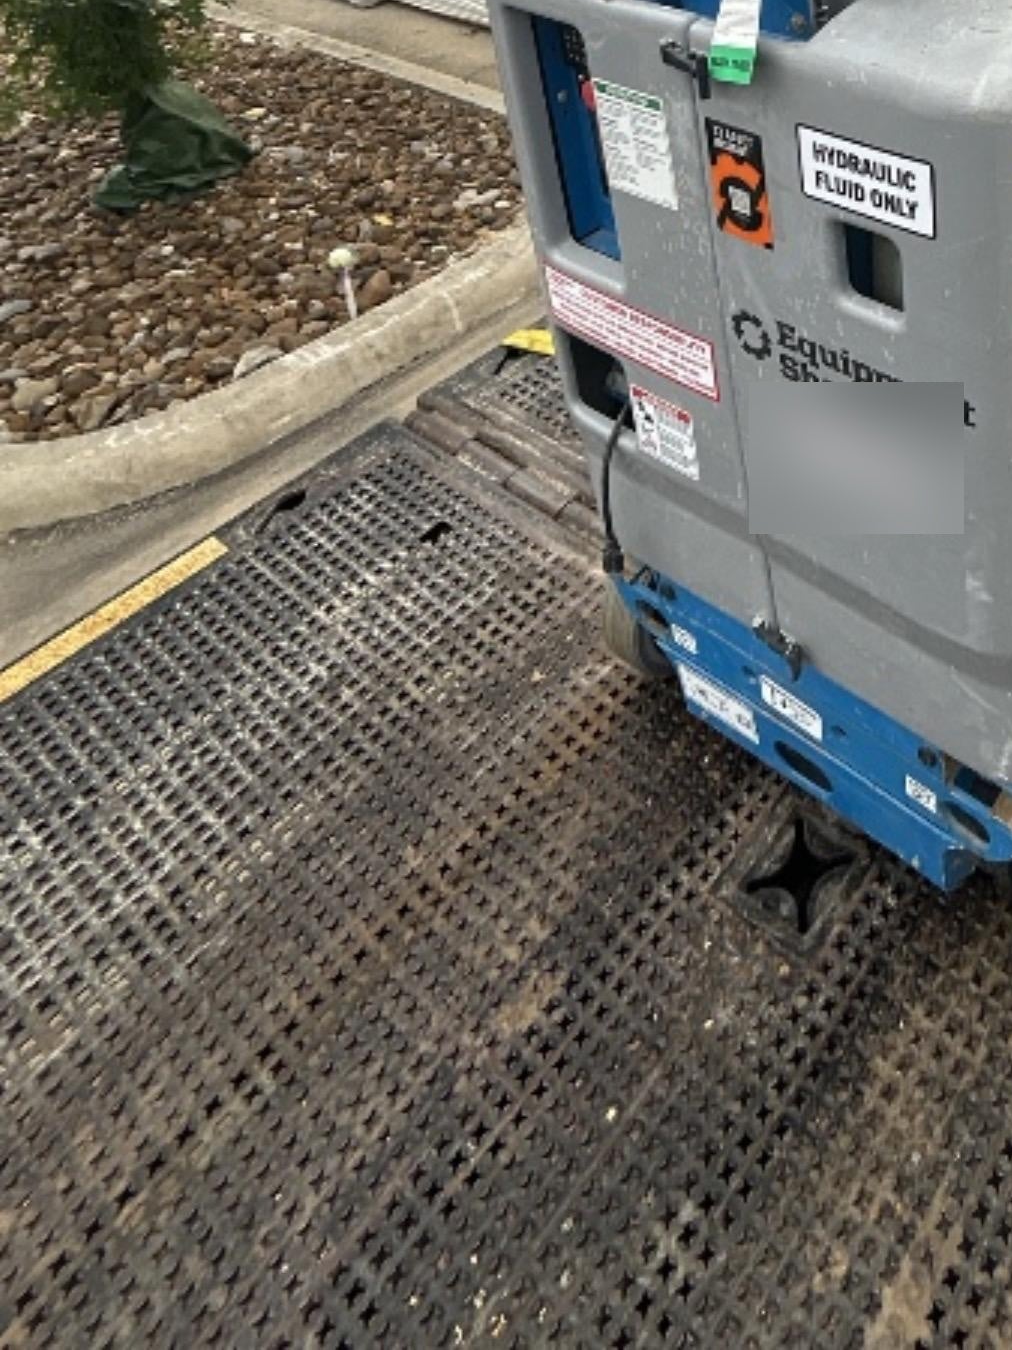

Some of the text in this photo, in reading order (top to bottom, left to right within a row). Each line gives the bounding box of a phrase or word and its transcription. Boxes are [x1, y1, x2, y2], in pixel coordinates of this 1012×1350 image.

[812, 141, 916, 192] HYDRAULIC
[815, 170, 919, 220] FLUID ONLY
